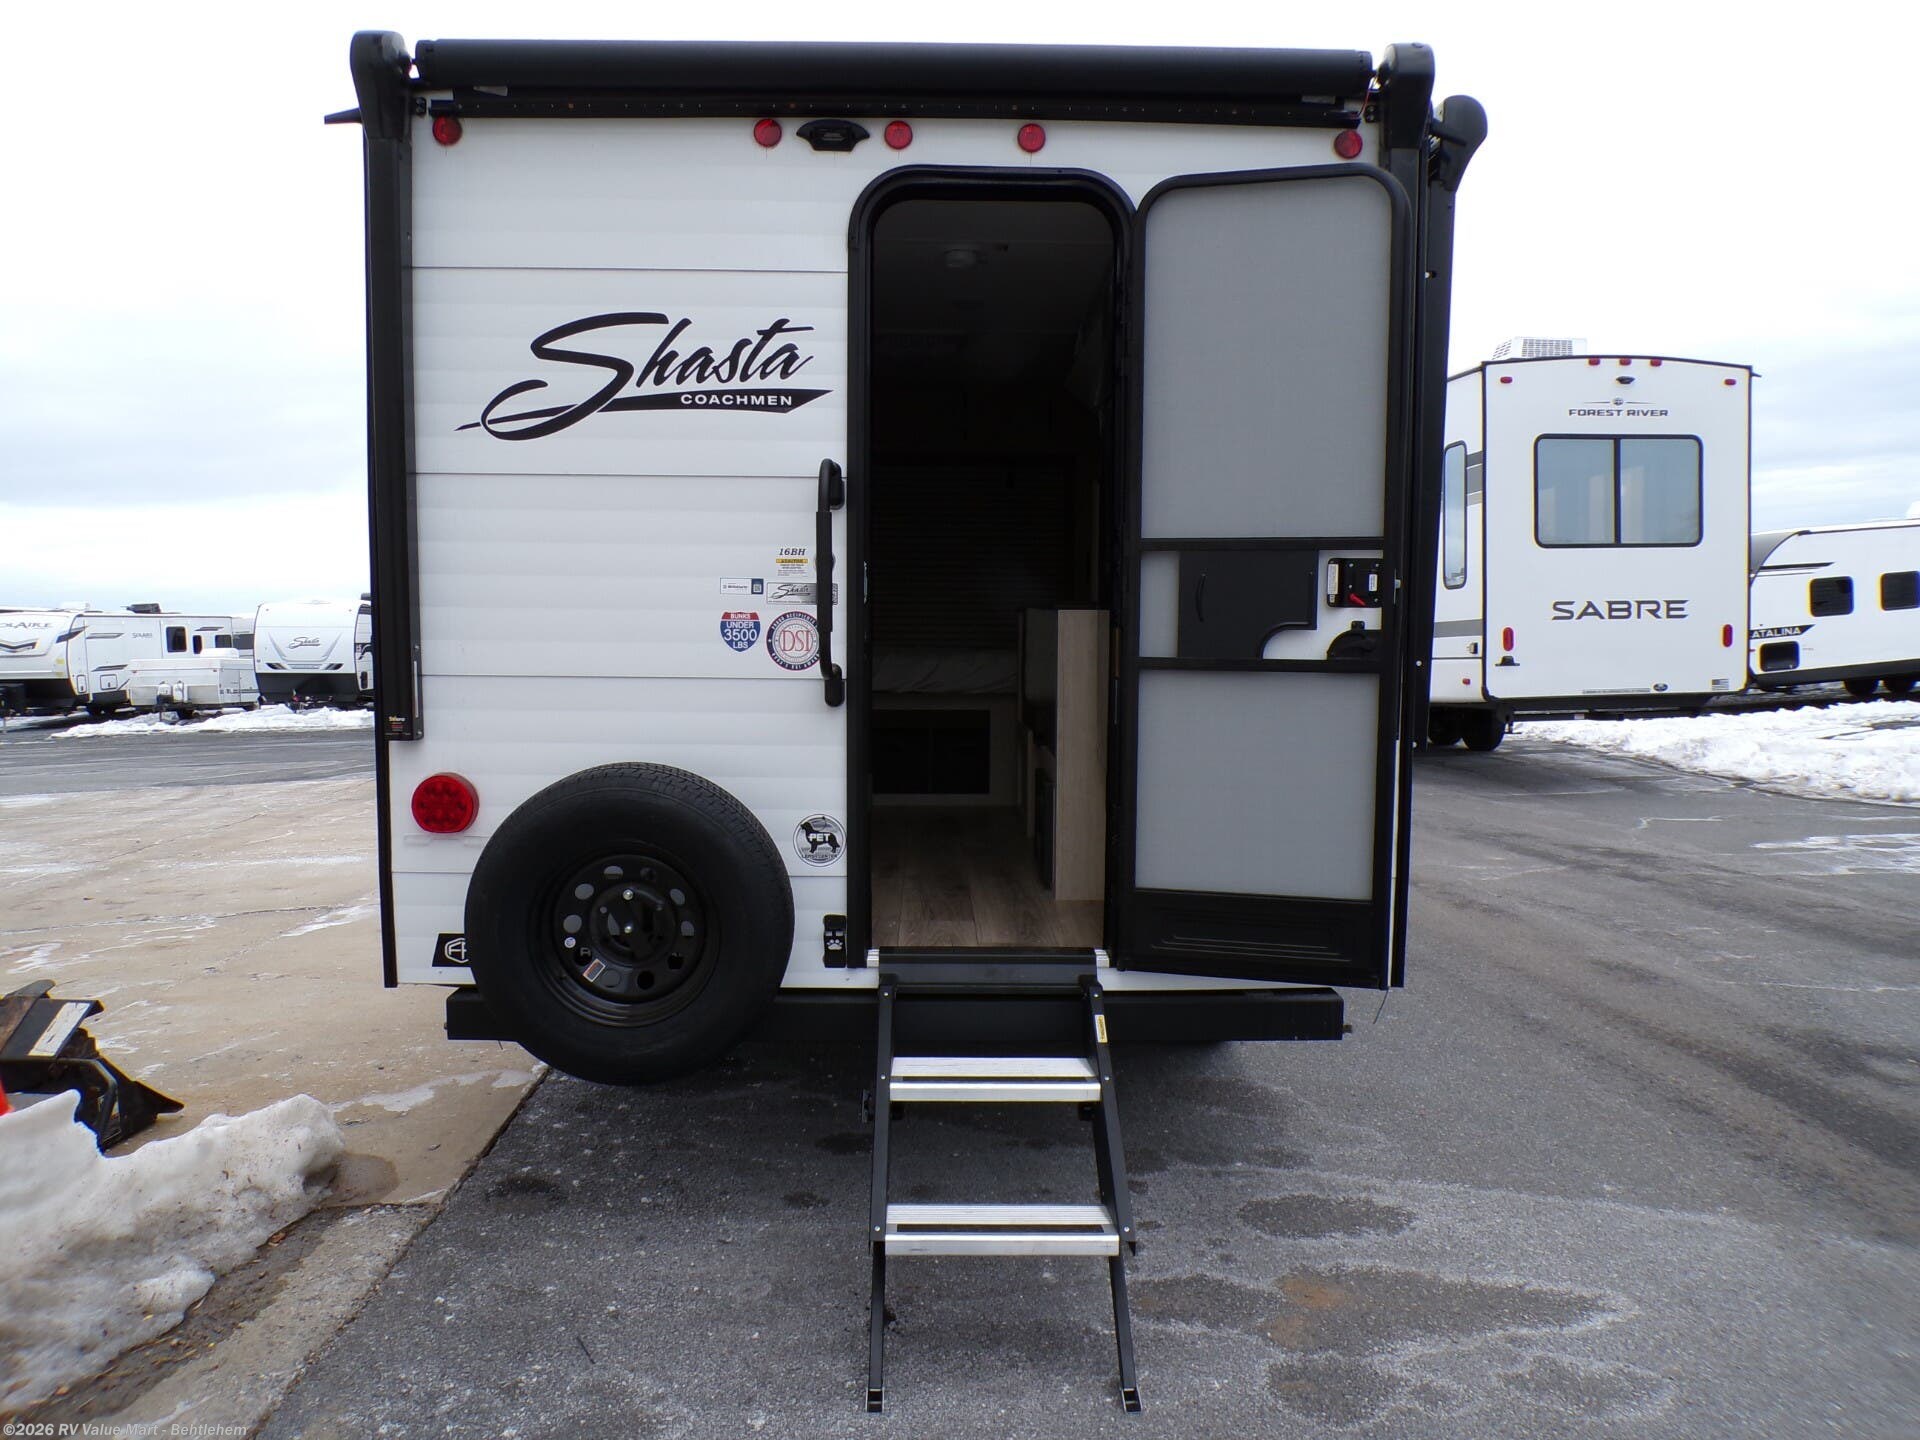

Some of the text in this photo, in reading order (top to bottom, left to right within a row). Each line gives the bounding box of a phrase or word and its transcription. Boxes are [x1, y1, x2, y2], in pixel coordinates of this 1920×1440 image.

[481, 312, 814, 441] Shasta
[680, 393, 793, 406] COACHMEN
[1568, 408, 1669, 417] FOREST RIVER
[779, 548, 806, 556] 16BH
[1551, 599, 1690, 621] SABRE
[726, 621, 755, 629] UNDER
[724, 629, 757, 641] 3500
[1751, 626, 1802, 639] ATALINA
[732, 641, 749, 649] LBS
[781, 629, 811, 652] DSI
[809, 833, 831, 842] PET
